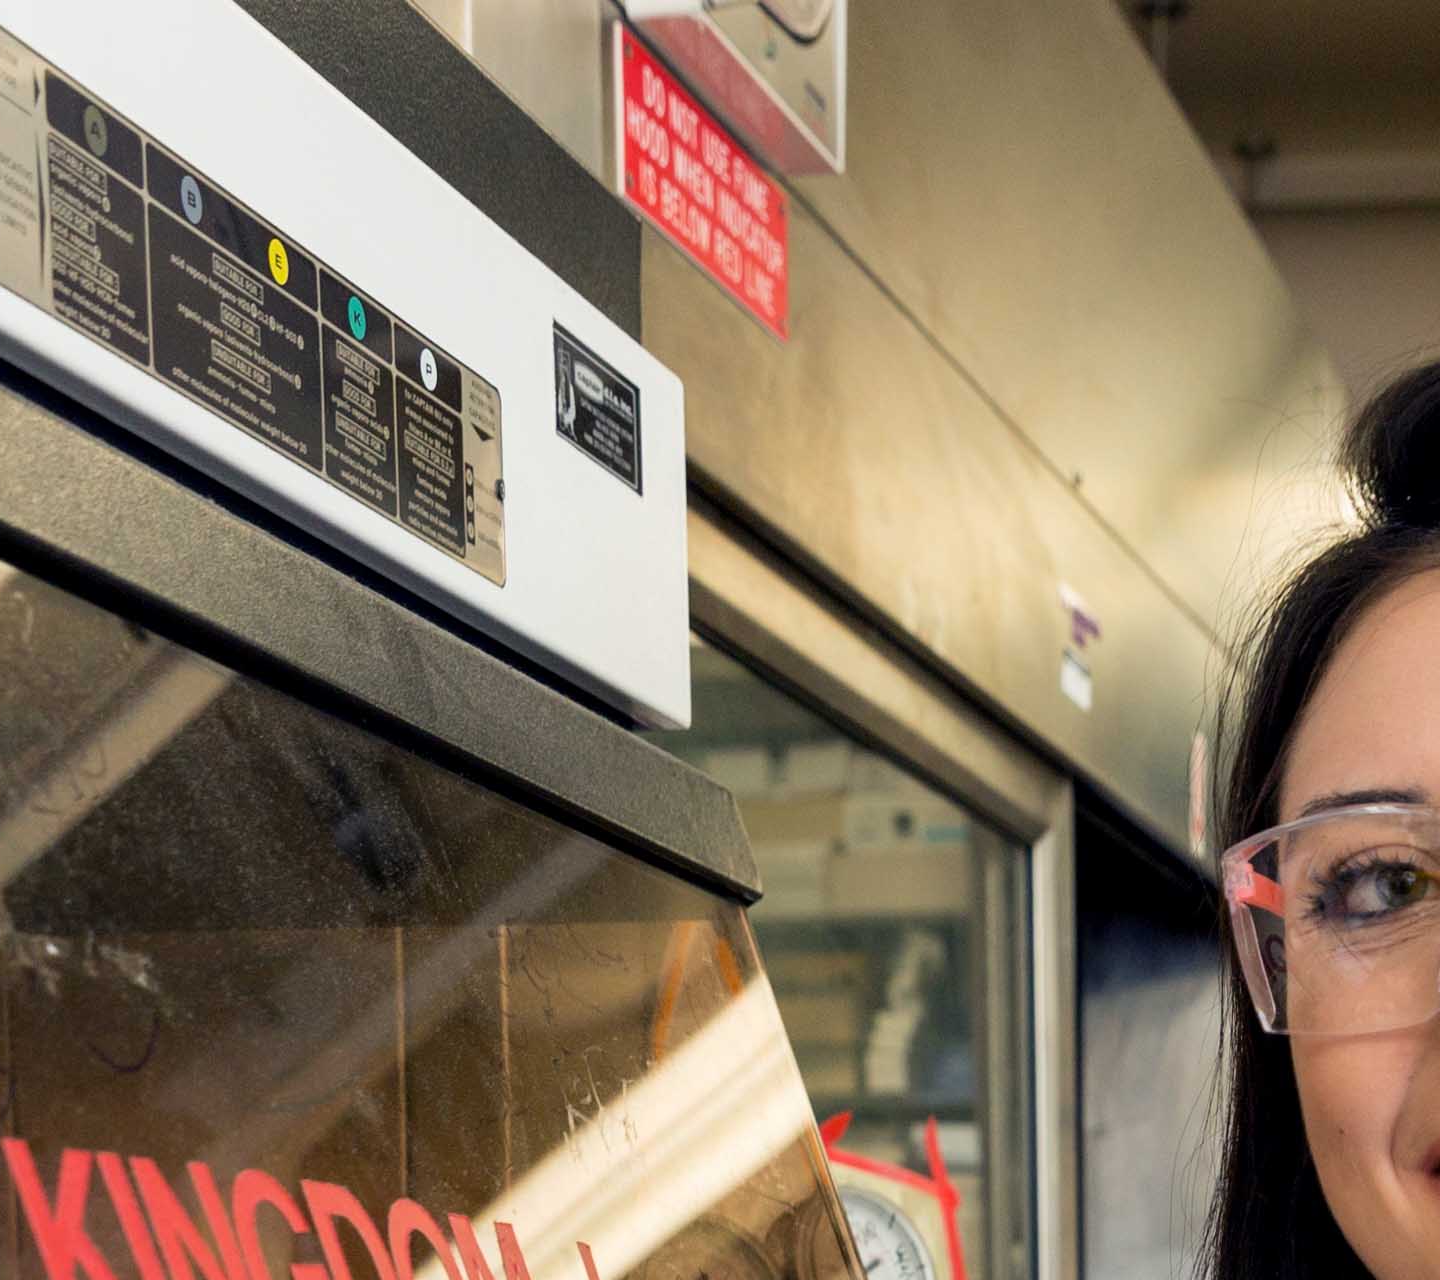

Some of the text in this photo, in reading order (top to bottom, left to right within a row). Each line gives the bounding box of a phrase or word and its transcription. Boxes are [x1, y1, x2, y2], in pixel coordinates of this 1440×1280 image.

[668, 92, 699, 150] NOT
[626, 98, 669, 169] HOOD
[673, 143, 714, 209] WHEN
[186, 191, 197, 209] B
[661, 177, 710, 251] BELOW
[714, 227, 743, 284] RED
[273, 253, 283, 271] E
[353, 311, 362, 327] K
[425, 362, 433, 375] P
